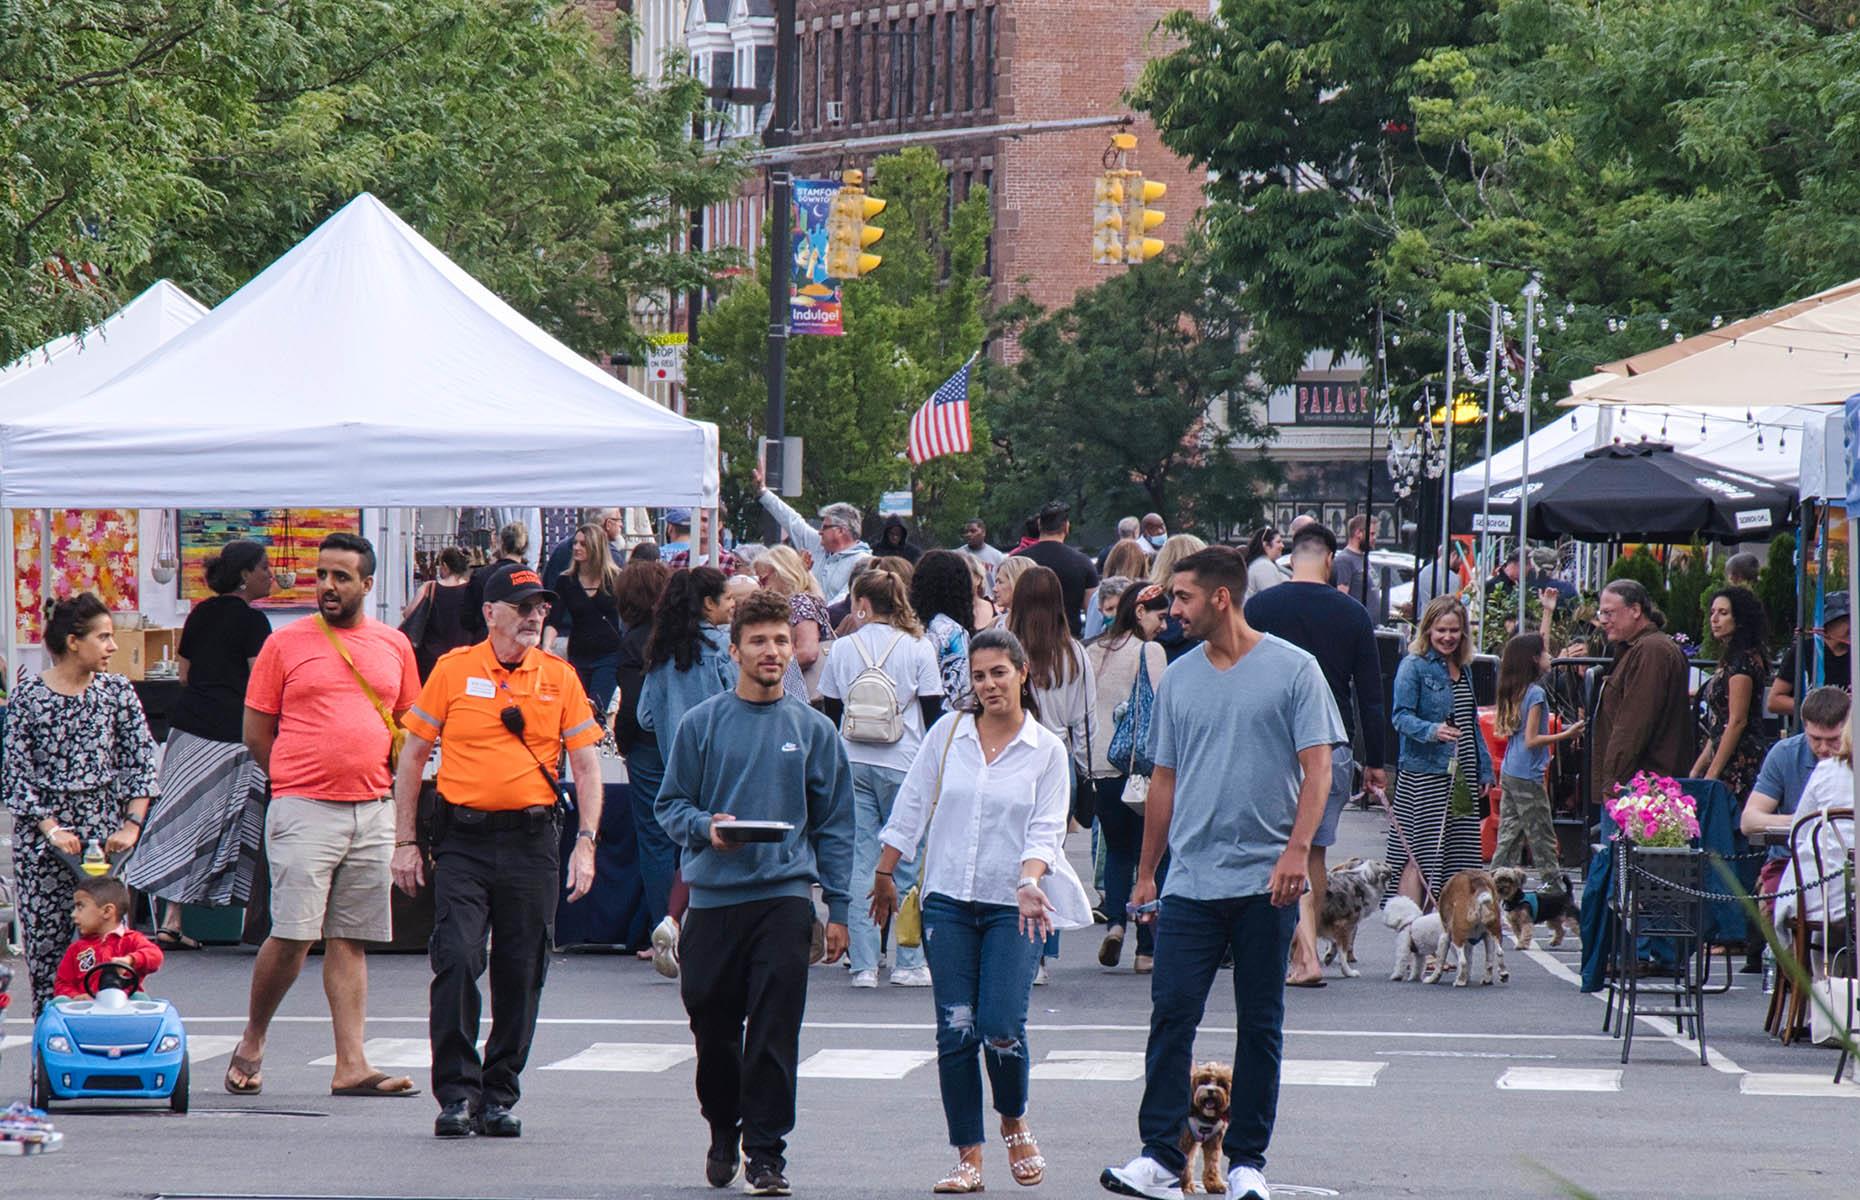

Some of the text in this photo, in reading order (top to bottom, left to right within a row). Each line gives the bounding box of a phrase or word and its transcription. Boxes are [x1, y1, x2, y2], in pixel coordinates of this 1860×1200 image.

[797, 188, 838, 196] STAMFOR
[793, 308, 839, 322] Indulge!
[1299, 386, 1368, 413] PALACE
